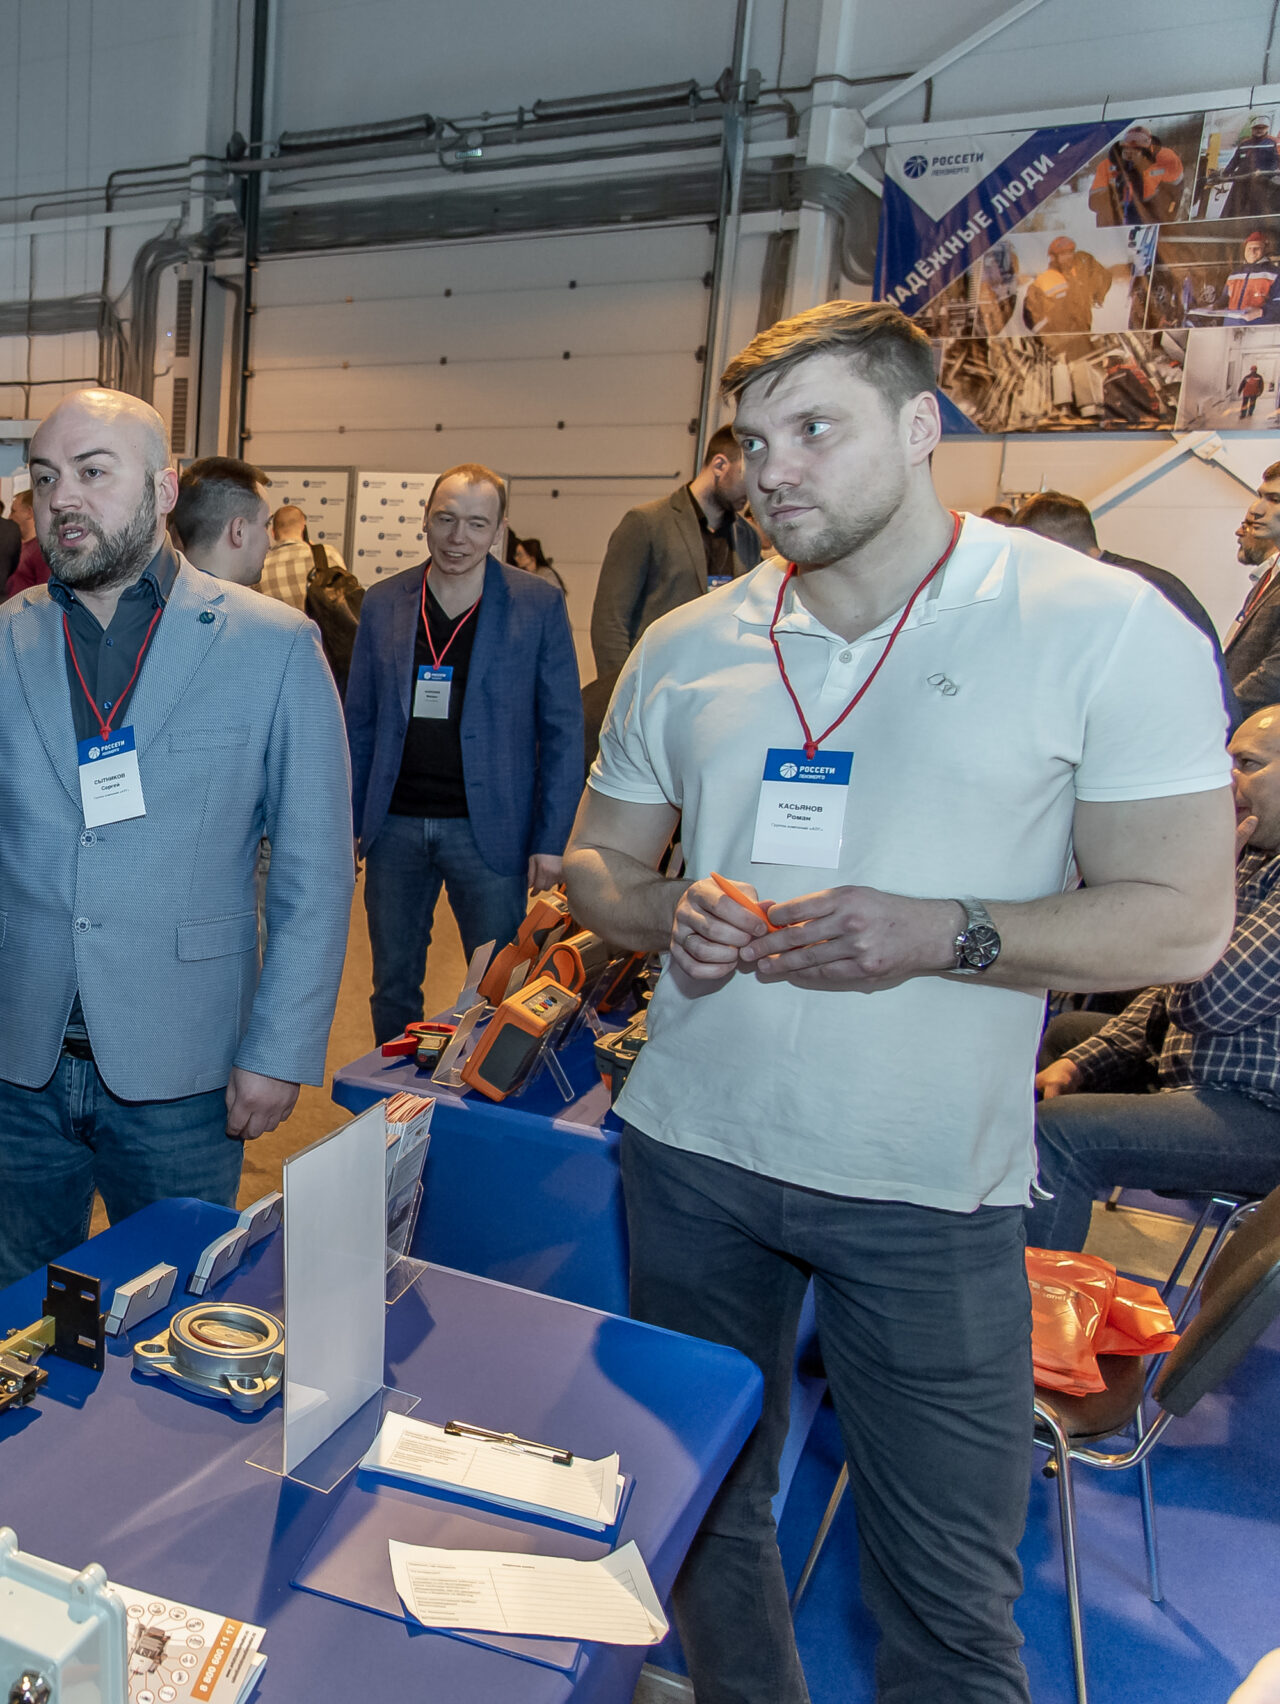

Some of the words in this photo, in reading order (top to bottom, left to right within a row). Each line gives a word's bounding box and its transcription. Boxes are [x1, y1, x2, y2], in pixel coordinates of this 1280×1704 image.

[931, 153, 984, 167] РОССЕТИ
[990, 154, 1055, 214] ЛЮДИ
[101, 740, 125, 752] РОССЕТИ
[799, 766, 836, 774] РОССЕТИ
[778, 803, 823, 812] КАСЬЯНОВ
[786, 813, 811, 821] Роман
[225, 1624, 235, 1634] 17
